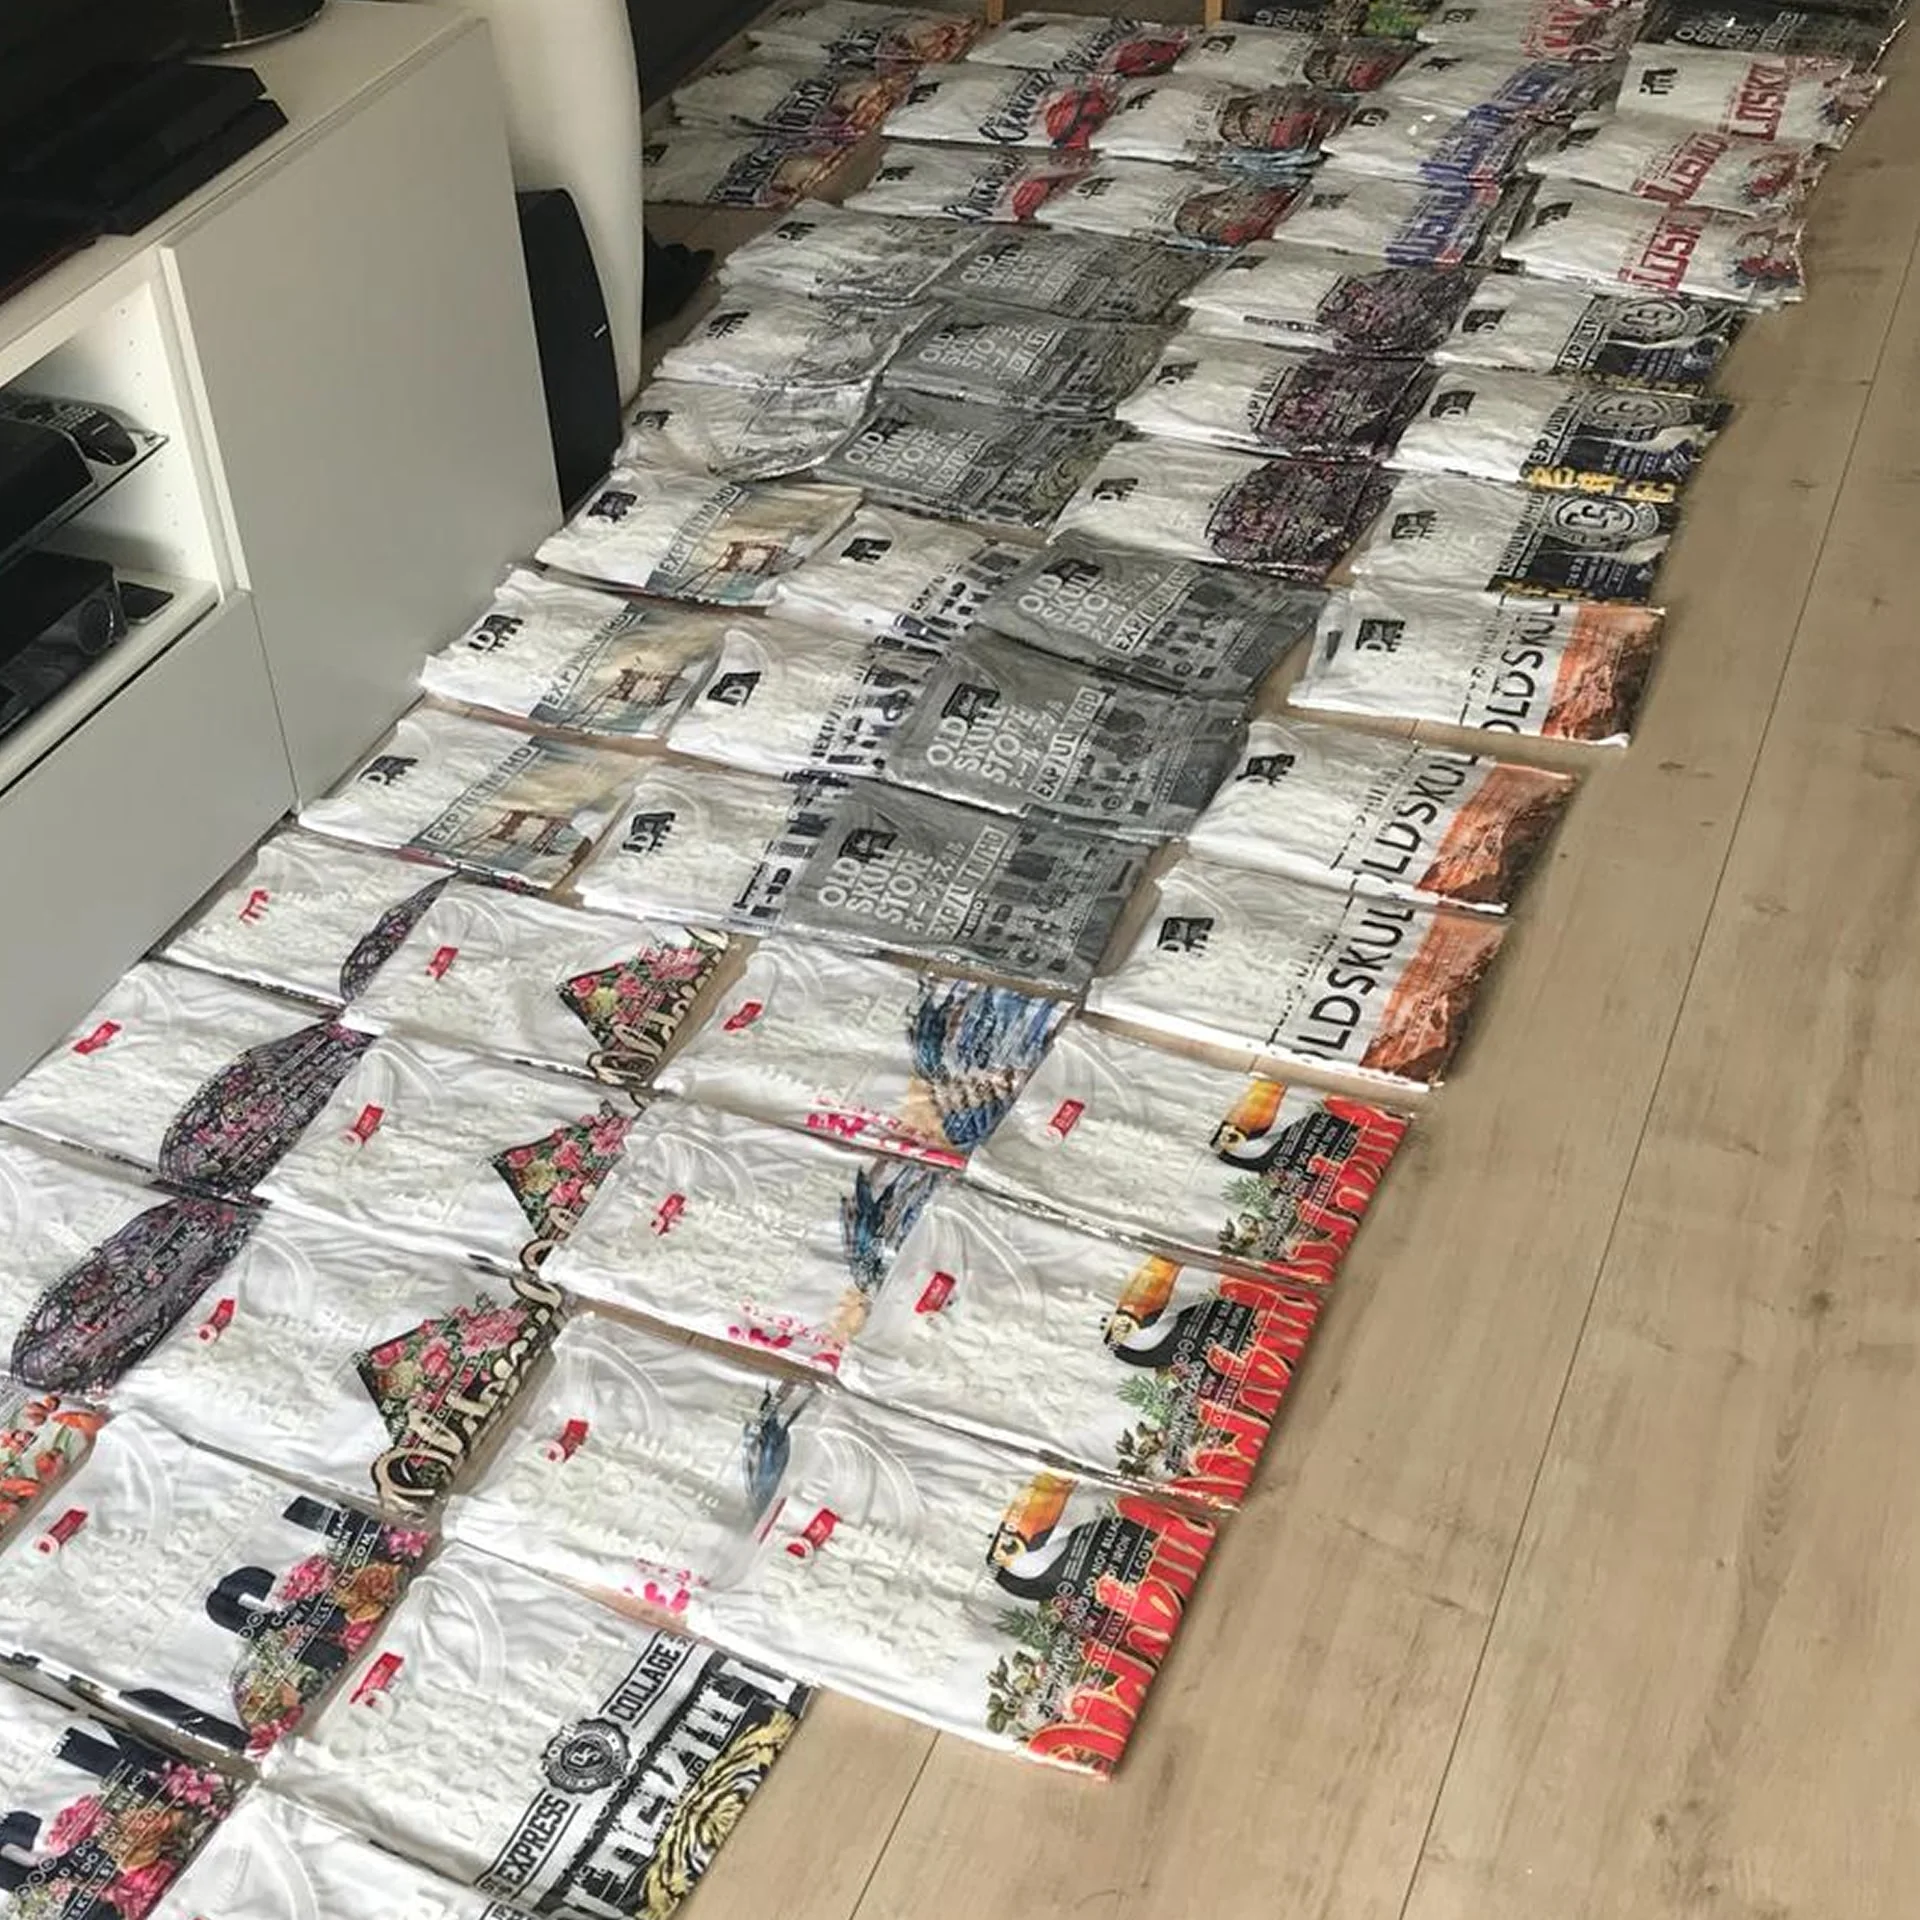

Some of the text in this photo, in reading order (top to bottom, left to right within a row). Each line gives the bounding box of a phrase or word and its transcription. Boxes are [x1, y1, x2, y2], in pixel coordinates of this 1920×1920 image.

[919, 332, 954, 363] OLD
[844, 431, 884, 464] OLD
[865, 427, 920, 473] SKULL
[1018, 573, 1062, 613] OLD
[1041, 572, 1100, 623] SKULL
[927, 716, 967, 766] OLD
[953, 702, 1008, 771] SKULL
[981, 705, 1035, 784] STORE
[818, 857, 861, 906] OLD
[845, 848, 903, 913] SKULL
[874, 851, 934, 924] STORE
[609, 1644, 680, 1721] COLLAGE
[494, 1794, 570, 1885] EXPRESS
